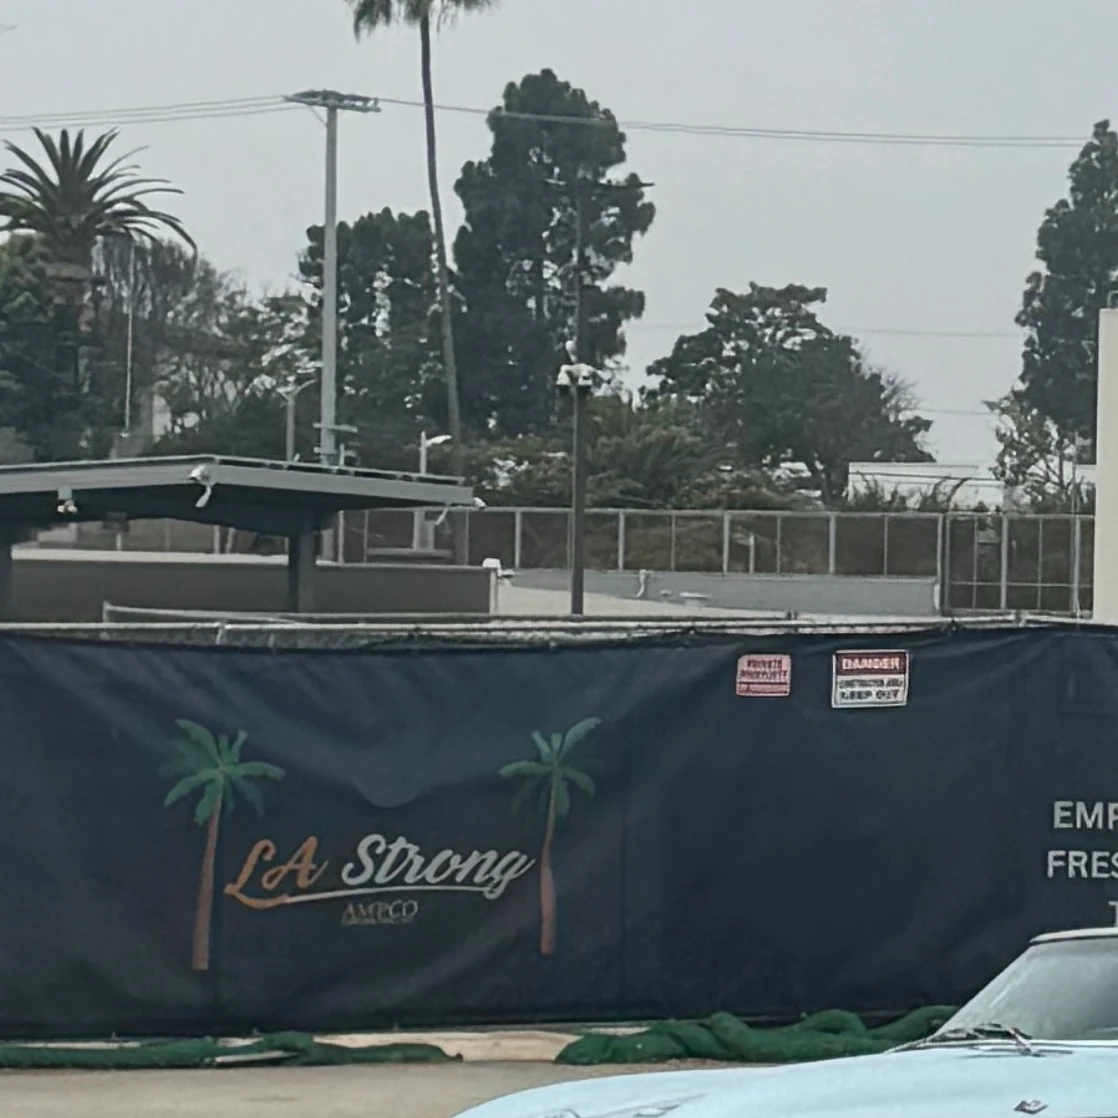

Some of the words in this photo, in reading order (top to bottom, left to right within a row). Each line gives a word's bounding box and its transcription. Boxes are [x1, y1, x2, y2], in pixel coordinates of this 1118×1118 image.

[842, 657, 900, 670] DANGER
[224, 836, 329, 901] LA
[341, 834, 536, 899] Strong
